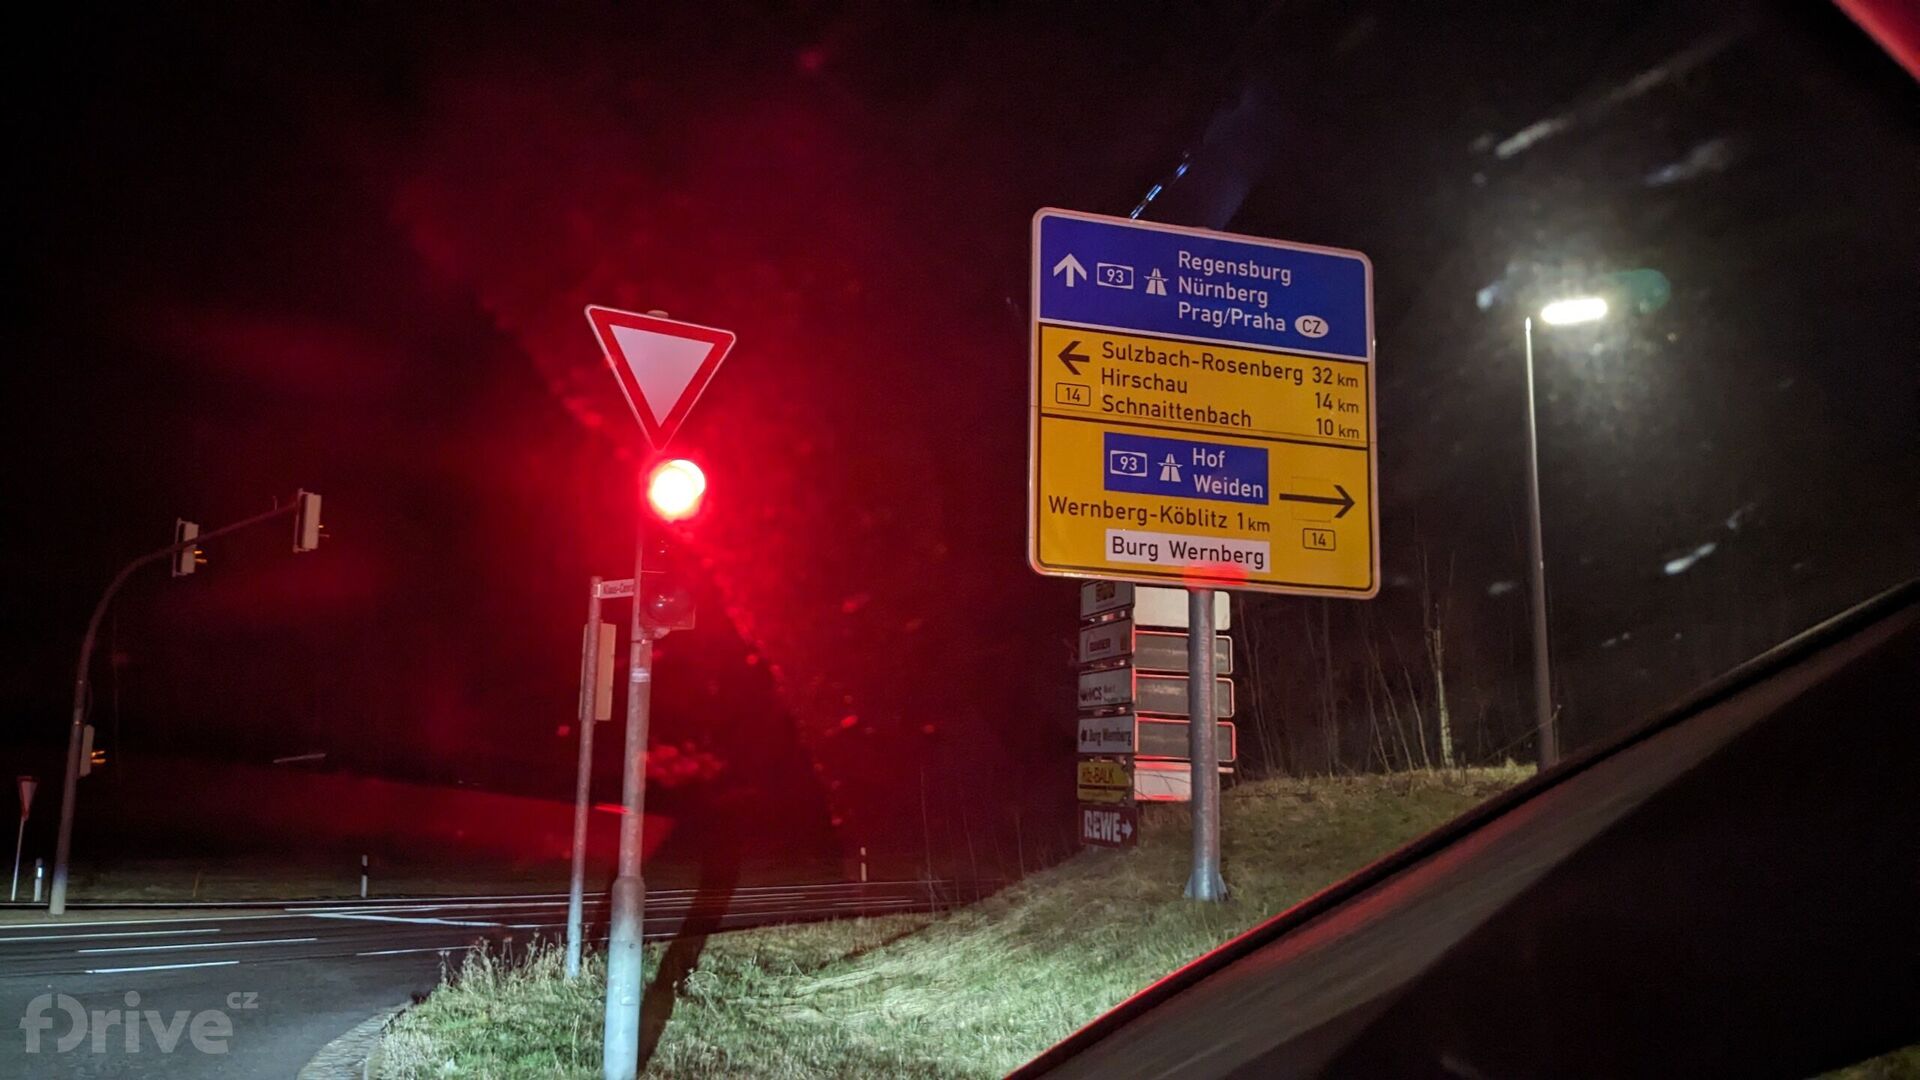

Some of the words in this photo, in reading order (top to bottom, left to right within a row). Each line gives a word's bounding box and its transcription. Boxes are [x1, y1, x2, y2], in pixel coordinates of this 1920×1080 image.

[1107, 269, 1123, 283] 93
[1178, 251, 1291, 286] Regensburg
[1178, 277, 1269, 306] Nürnberg
[1179, 303, 1285, 332] Prag/Praha
[1302, 320, 1321, 334] CZ
[1102, 341, 1303, 385] Sulzbach-Rosenberg
[1312, 367, 1332, 384] 32
[1337, 373, 1358, 387] km
[1066, 388, 1080, 401] 14
[1102, 368, 1188, 393] Hirschau
[1315, 393, 1332, 410] 14
[1338, 399, 1359, 413] km
[1102, 395, 1251, 427] Schnaittenbach
[1317, 419, 1333, 436] 10
[1338, 425, 1359, 438] km
[1119, 456, 1137, 470] 93
[1193, 448, 1225, 467] Hof
[1194, 474, 1263, 498] Weiden
[1049, 496, 1228, 528] Wernberg-Köblitz
[1237, 512, 1244, 531] 1
[1248, 517, 1270, 532] km
[1112, 537, 1158, 561] Burg
[1169, 541, 1265, 570] Wernberg
[1312, 533, 1326, 546] 14
[1084, 810, 1121, 843] REWE
